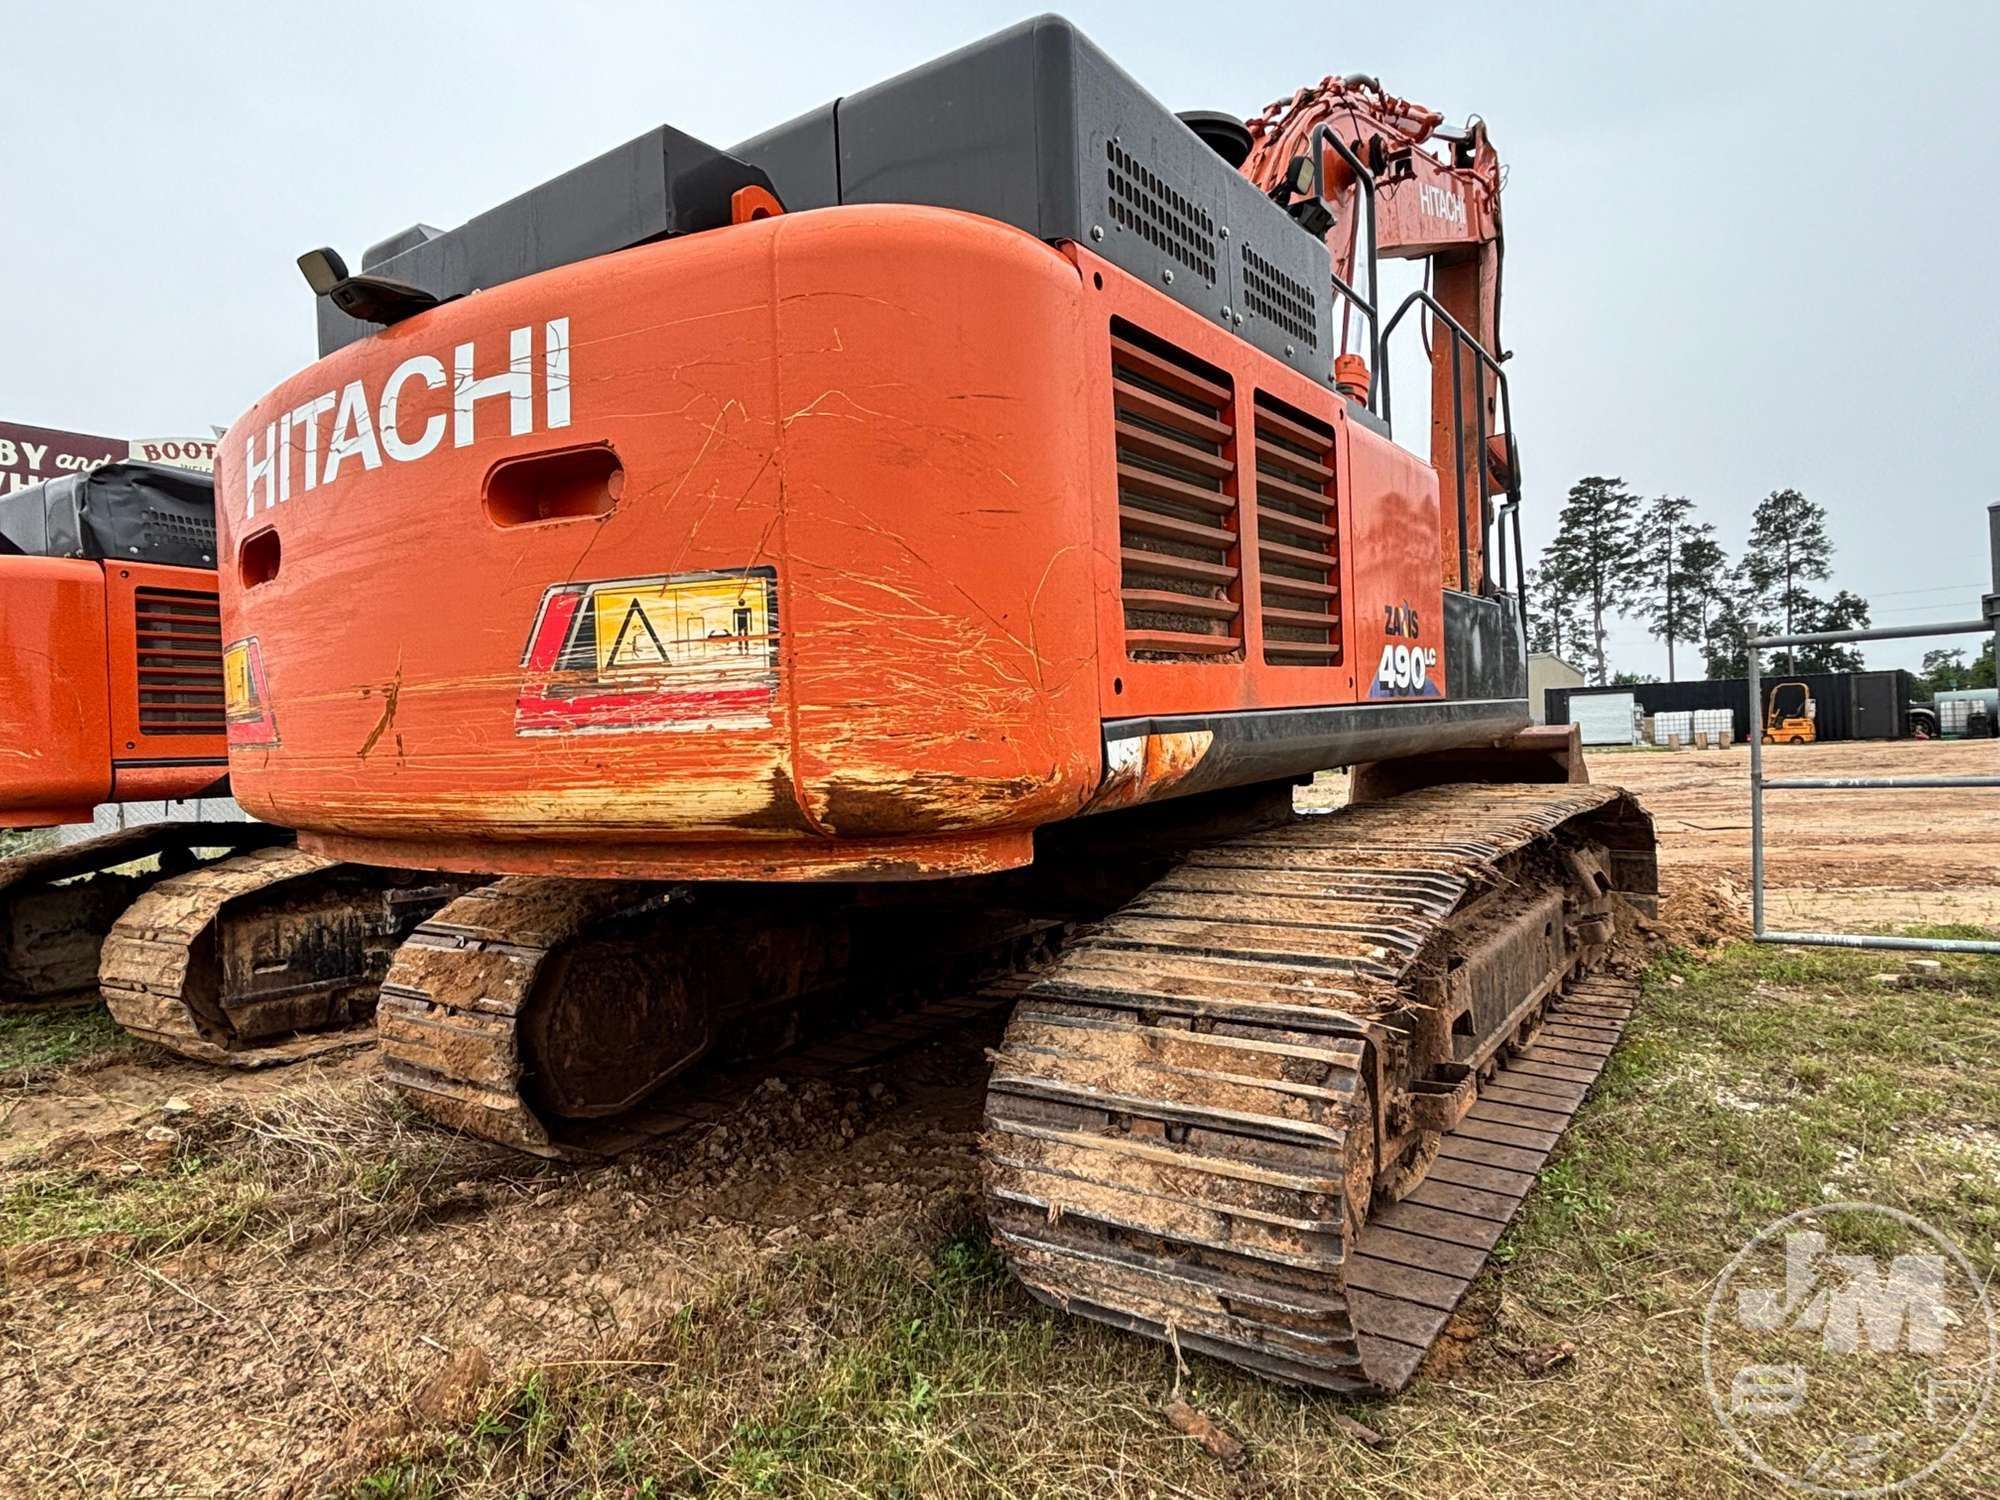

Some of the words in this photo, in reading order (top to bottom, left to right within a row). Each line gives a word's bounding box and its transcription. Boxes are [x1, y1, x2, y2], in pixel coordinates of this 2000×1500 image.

[1419, 182, 1466, 225] HITACHI
[246, 316, 572, 520] HITACHI
[56, 453, 112, 472] and
